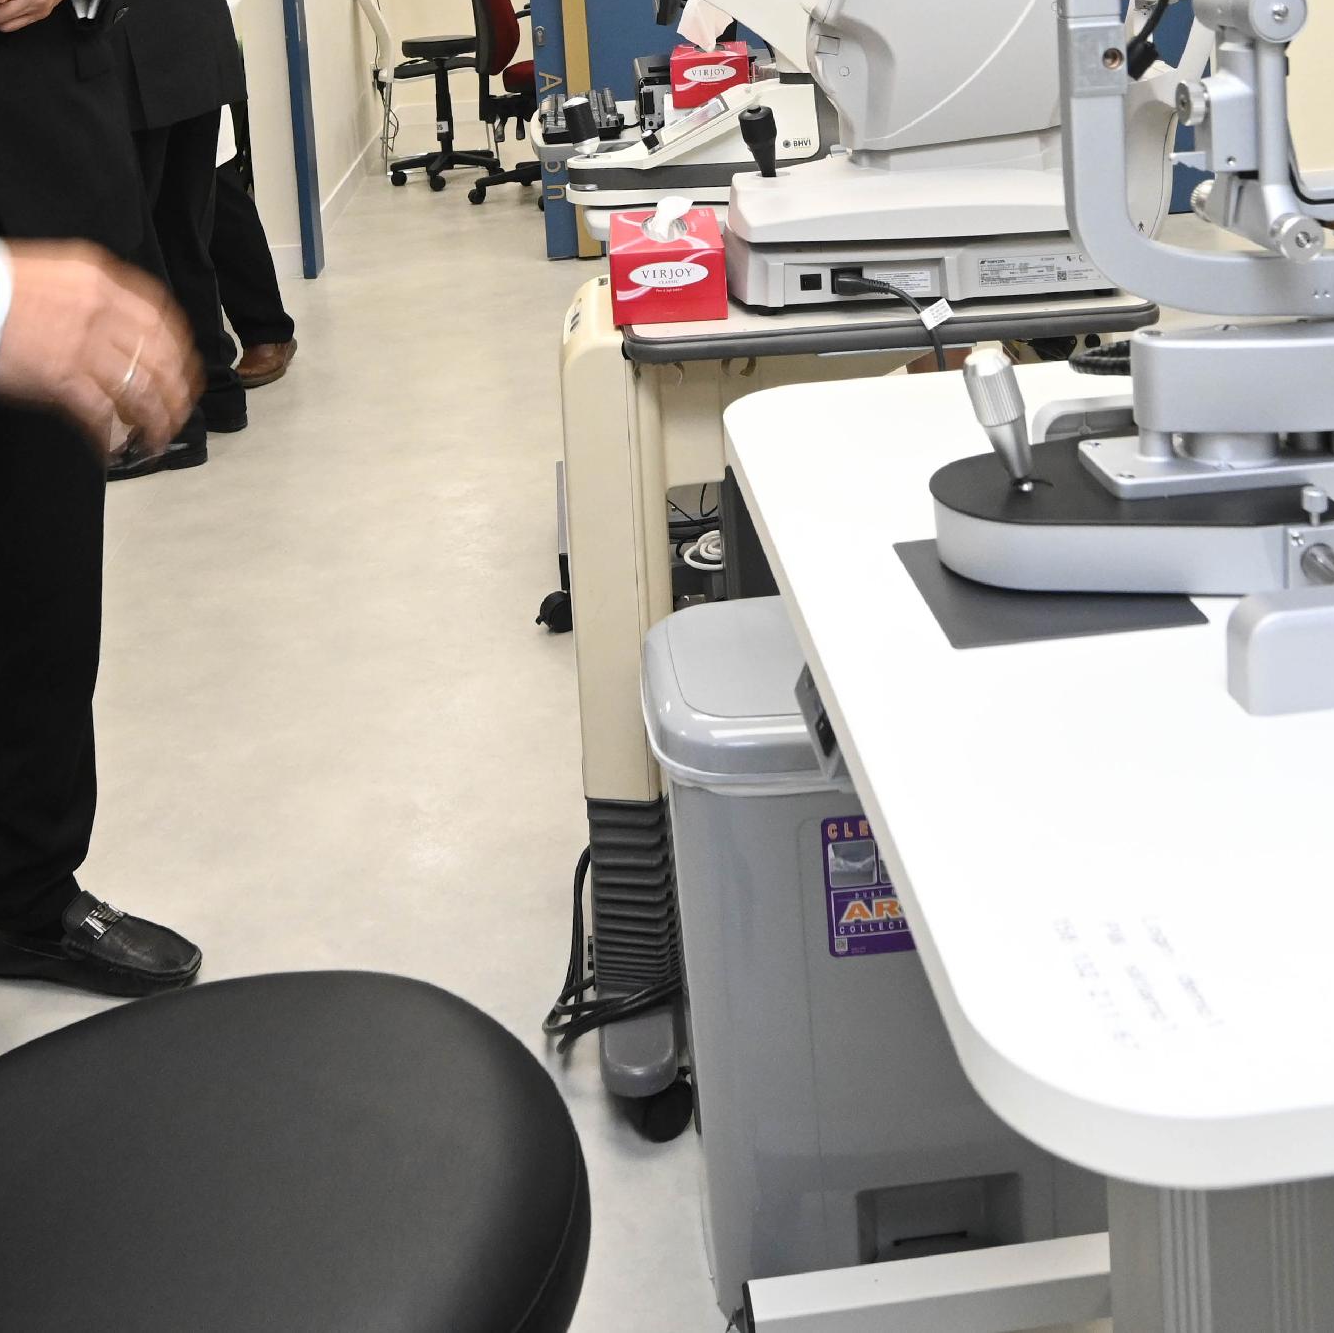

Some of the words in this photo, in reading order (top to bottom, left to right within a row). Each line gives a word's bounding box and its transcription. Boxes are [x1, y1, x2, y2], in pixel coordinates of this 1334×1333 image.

[691, 68, 726, 77] VIRJOY
[793, 139, 812, 147] BHVI
[641, 267, 693, 280] VIRJOY
[827, 819, 870, 840] CLE
[839, 897, 905, 925] AR
[838, 920, 910, 935] COLLECT
